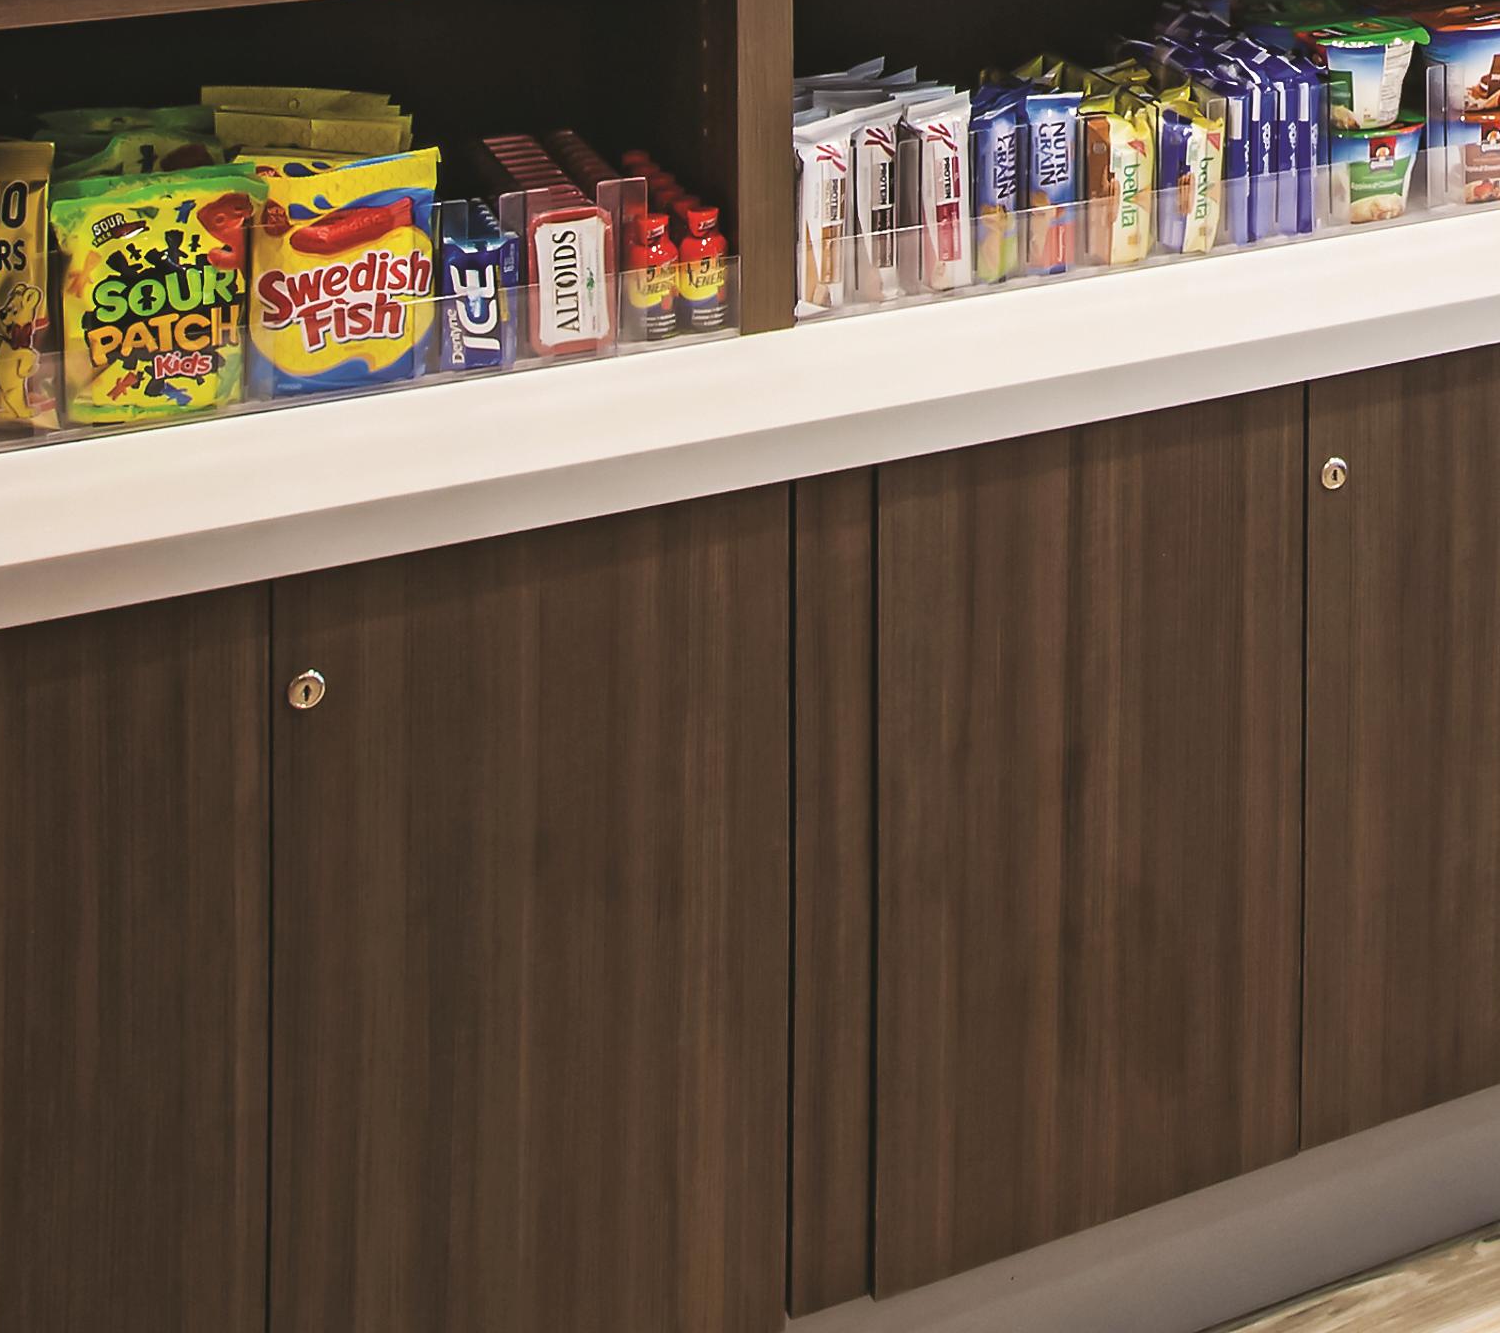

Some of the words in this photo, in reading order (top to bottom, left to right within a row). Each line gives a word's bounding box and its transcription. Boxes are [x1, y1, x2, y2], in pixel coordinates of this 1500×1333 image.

[942, 156, 950, 199] PROTEIN
[1038, 123, 1057, 188] GRAIN
[1050, 121, 1069, 184] NUTRI
[830, 178, 839, 221] PROTEIN
[1121, 163, 1141, 228] belvita
[1194, 156, 1214, 221] belvita
[92, 213, 126, 238] SOUR
[92, 265, 238, 324] SOUR
[256, 249, 433, 330] Swedish
[450, 263, 501, 351] ICE
[551, 229, 581, 333] ALTOIDS
[86, 303, 242, 368] PATCH
[294, 292, 405, 354] Fish
[447, 307, 466, 365] Dentyne
[153, 351, 213, 380] Kids
